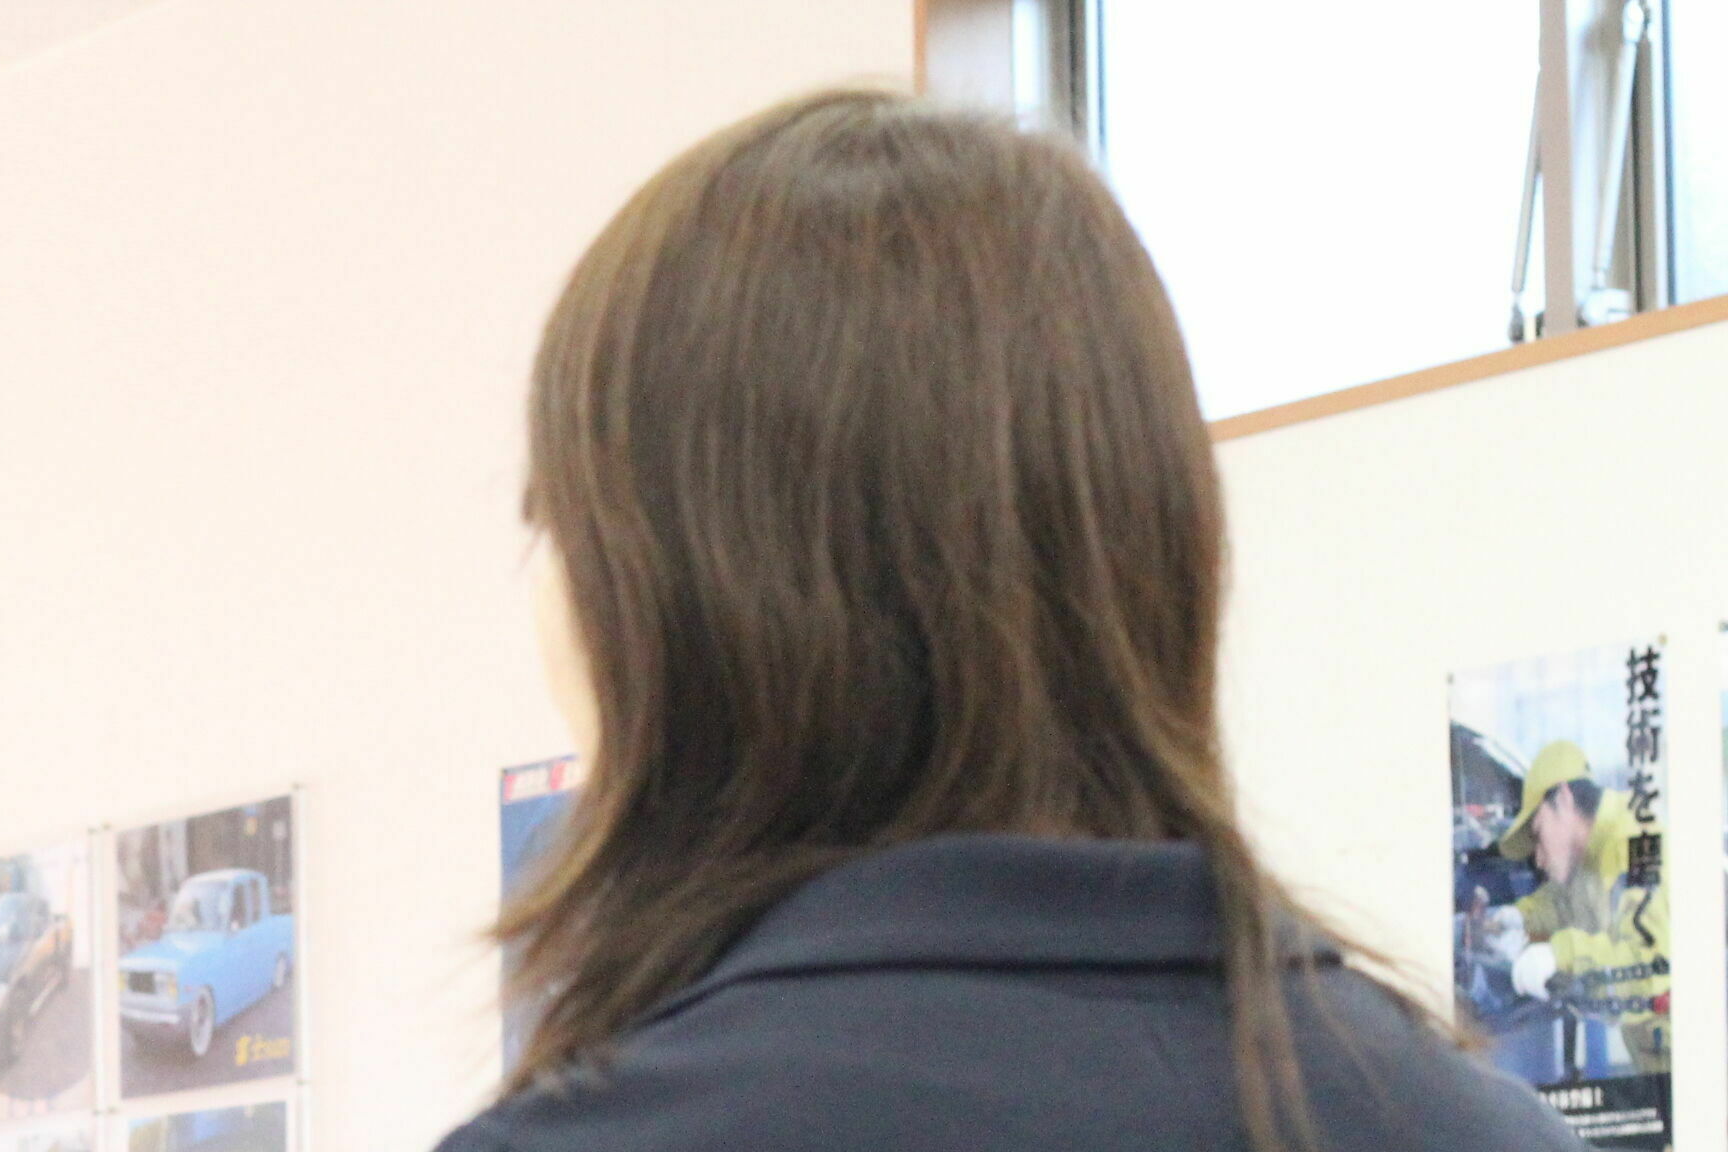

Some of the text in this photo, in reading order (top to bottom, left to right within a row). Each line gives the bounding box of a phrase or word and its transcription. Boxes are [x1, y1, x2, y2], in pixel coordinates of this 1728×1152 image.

[1626, 646, 1662, 949] 技術を磨く
